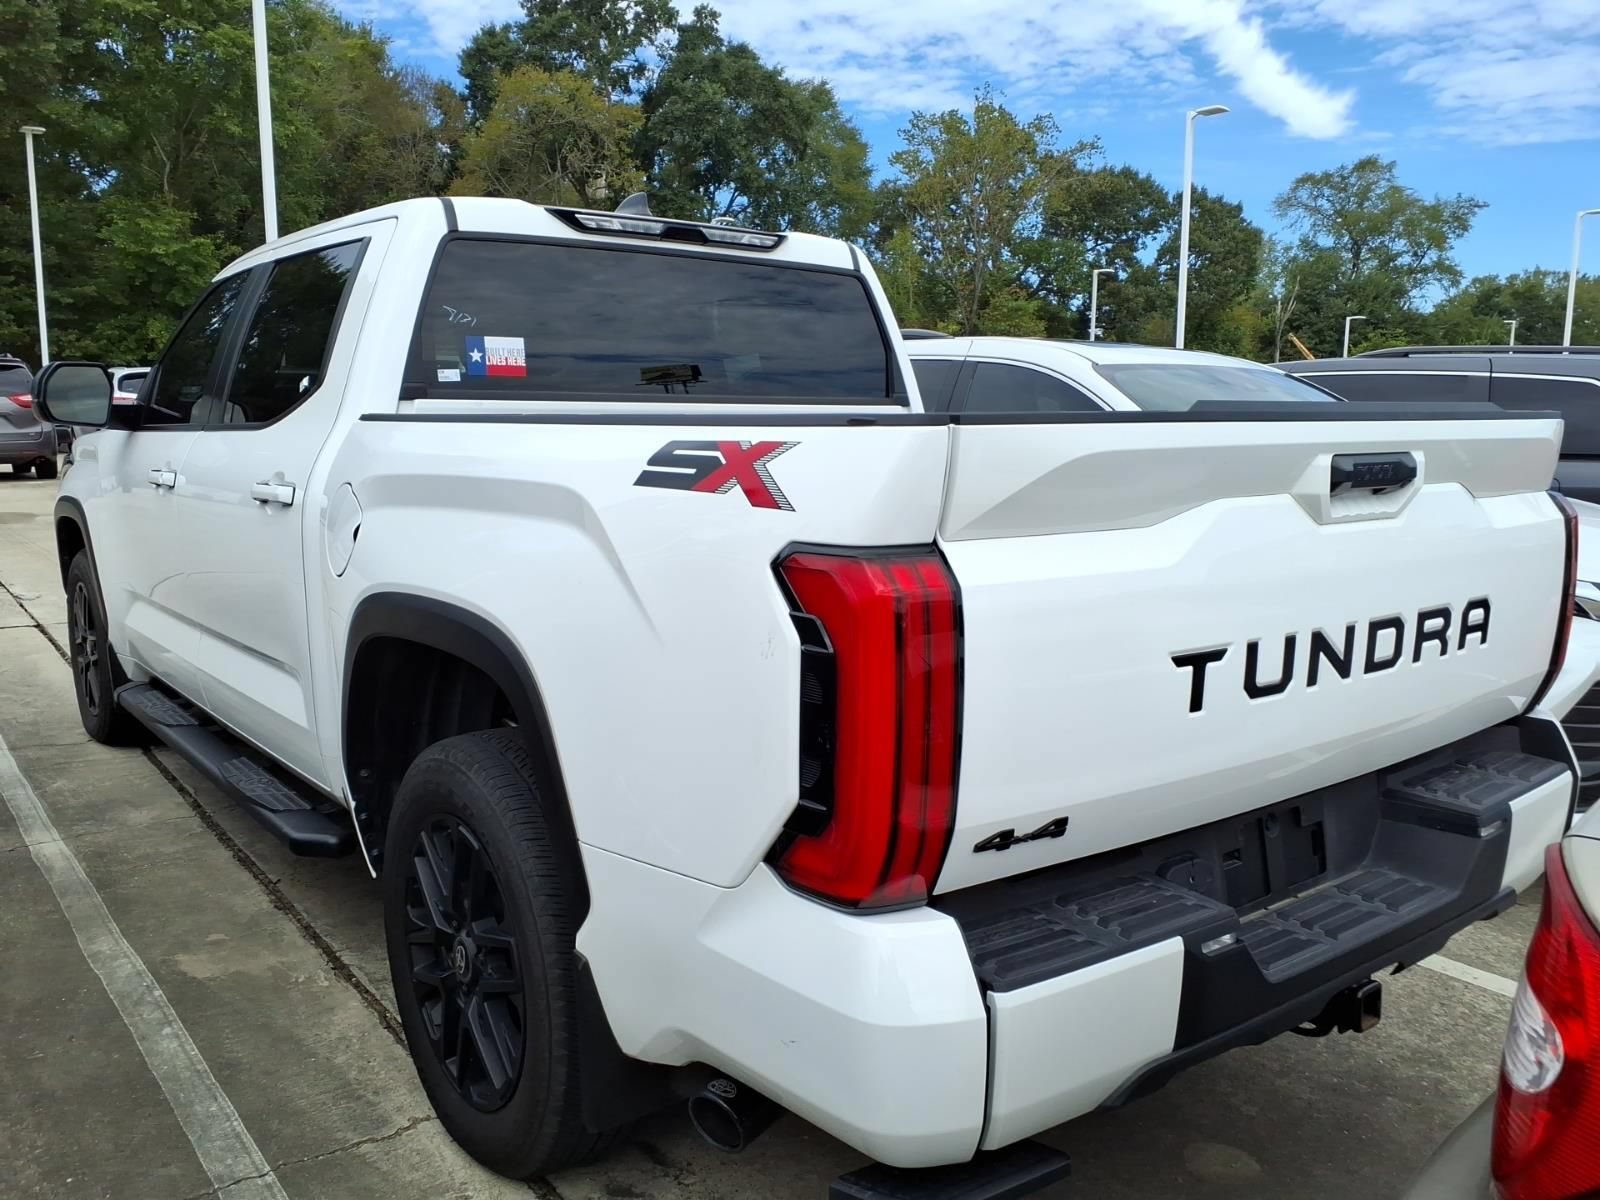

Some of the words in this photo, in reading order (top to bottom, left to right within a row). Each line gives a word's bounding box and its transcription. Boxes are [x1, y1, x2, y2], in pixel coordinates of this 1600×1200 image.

[486, 347, 505, 356] BUILT
[507, 347, 525, 358] HERE
[486, 355, 506, 366] LIVES
[507, 356, 526, 367] HERE
[632, 440, 802, 512] SX
[1169, 595, 1492, 715] TUNDRA
